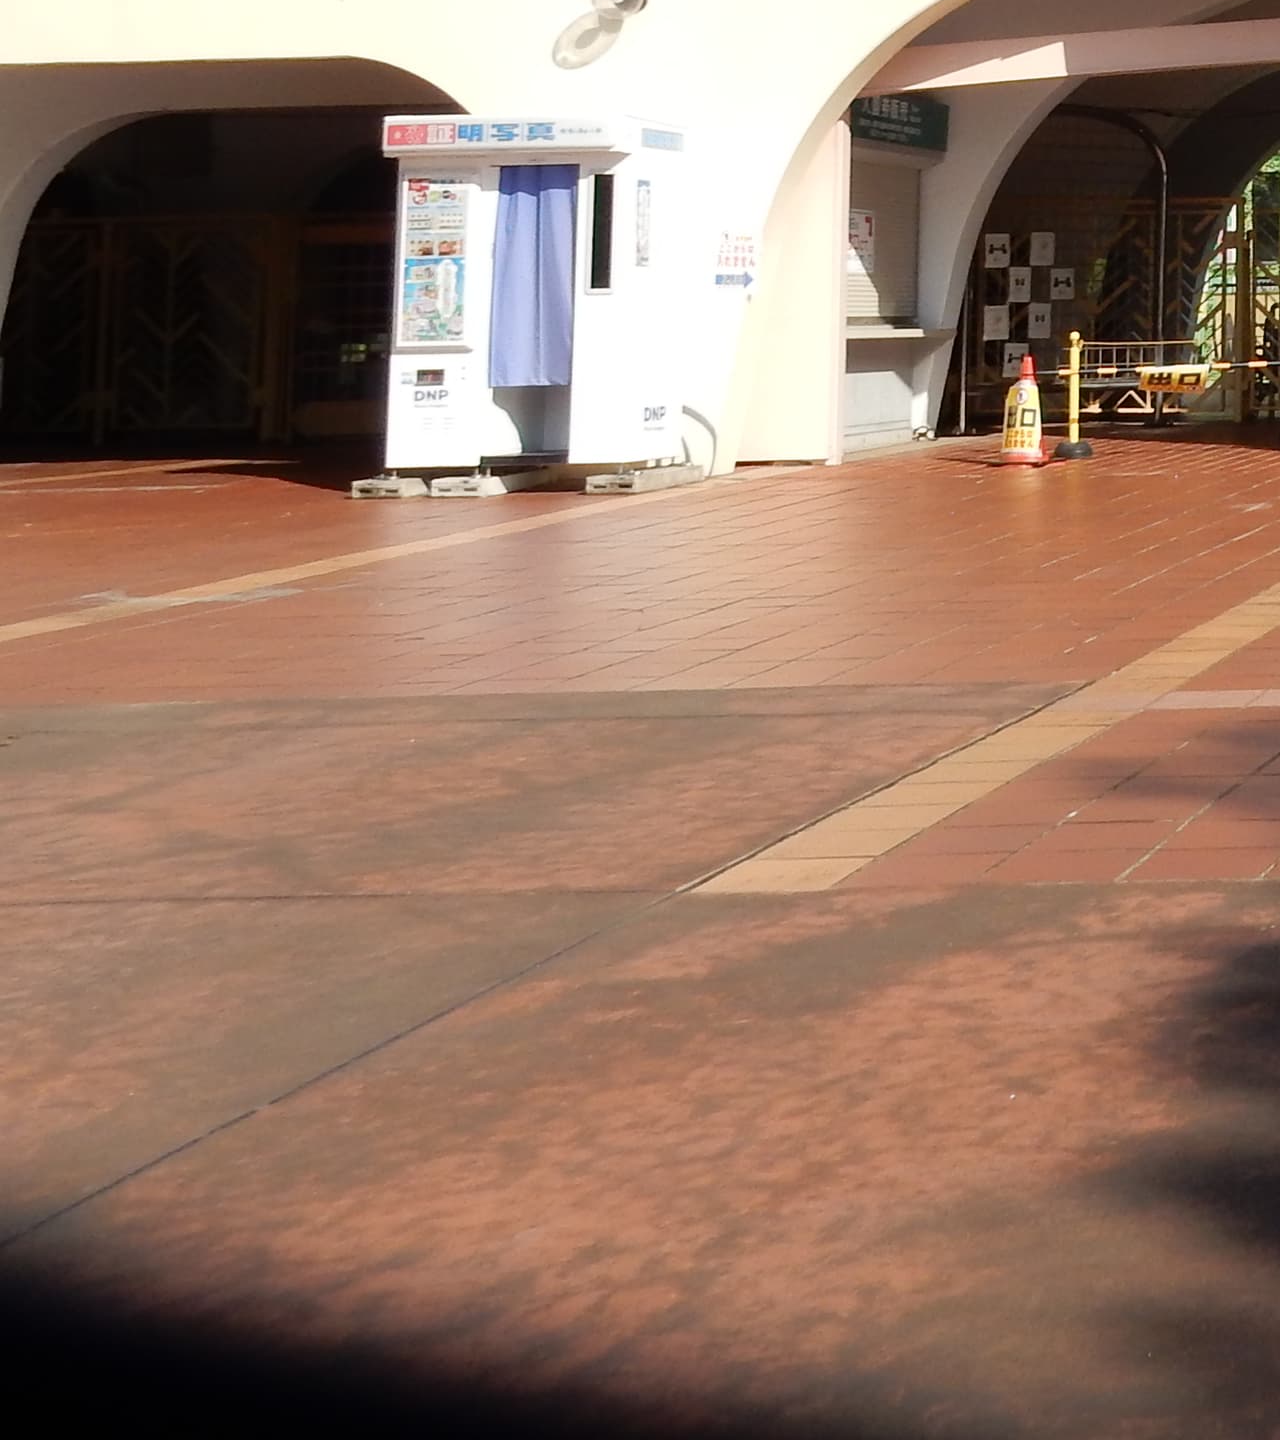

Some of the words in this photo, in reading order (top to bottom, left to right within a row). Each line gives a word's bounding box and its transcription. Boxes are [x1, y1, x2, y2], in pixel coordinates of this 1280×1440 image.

[1149, 372, 1201, 386] 出口
[414, 390, 448, 402] DNP
[643, 405, 666, 422] DNP
